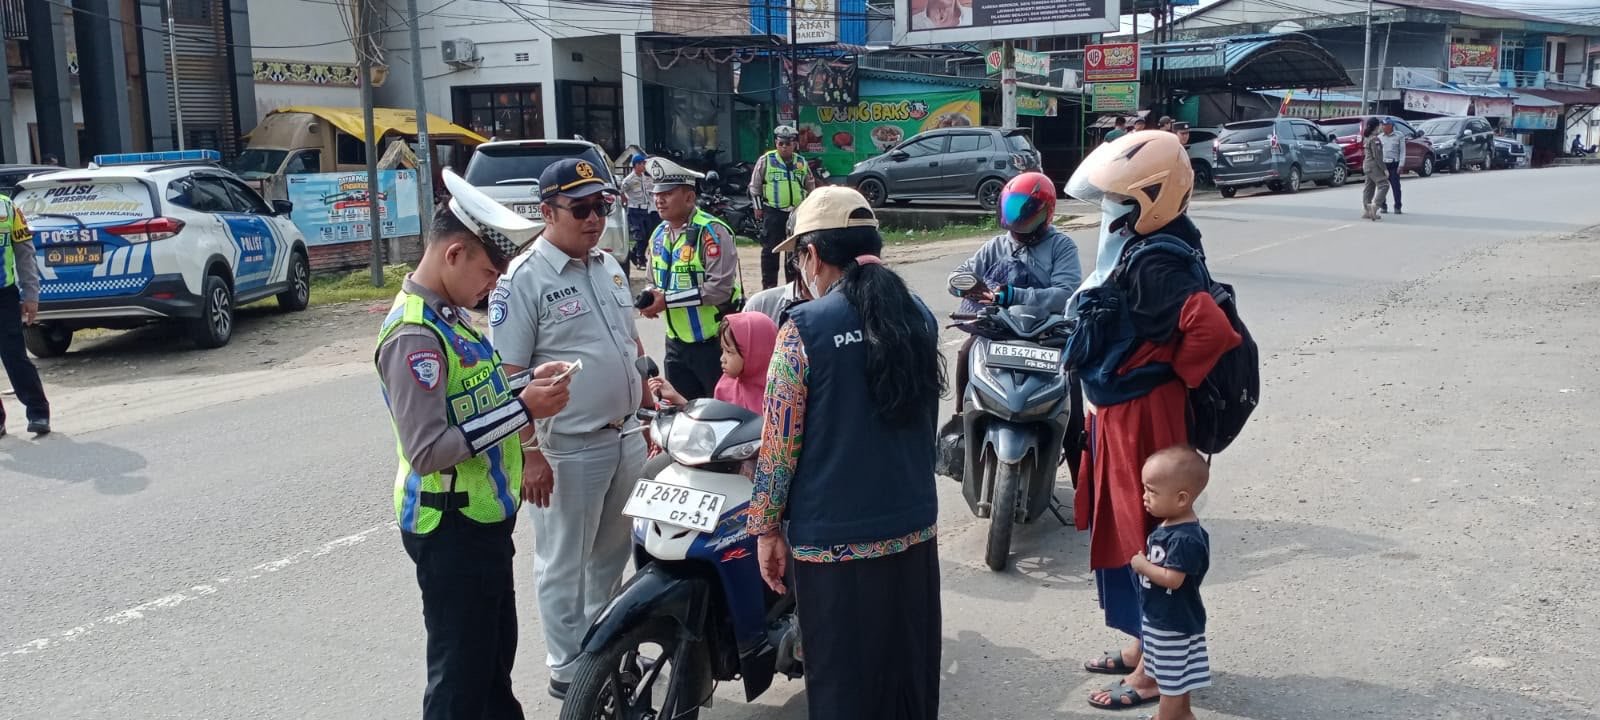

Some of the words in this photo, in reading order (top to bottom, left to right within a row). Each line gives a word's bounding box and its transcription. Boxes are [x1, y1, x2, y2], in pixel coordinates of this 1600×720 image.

[45, 184, 96, 198] POLISI
[833, 329, 864, 348] PAJ
[995, 346, 1008, 355] KB
[1040, 351, 1054, 360] KY
[465, 370, 488, 387] RIKO
[635, 483, 647, 497] H
[651, 486, 690, 504] 2678
[698, 494, 719, 512] FA
